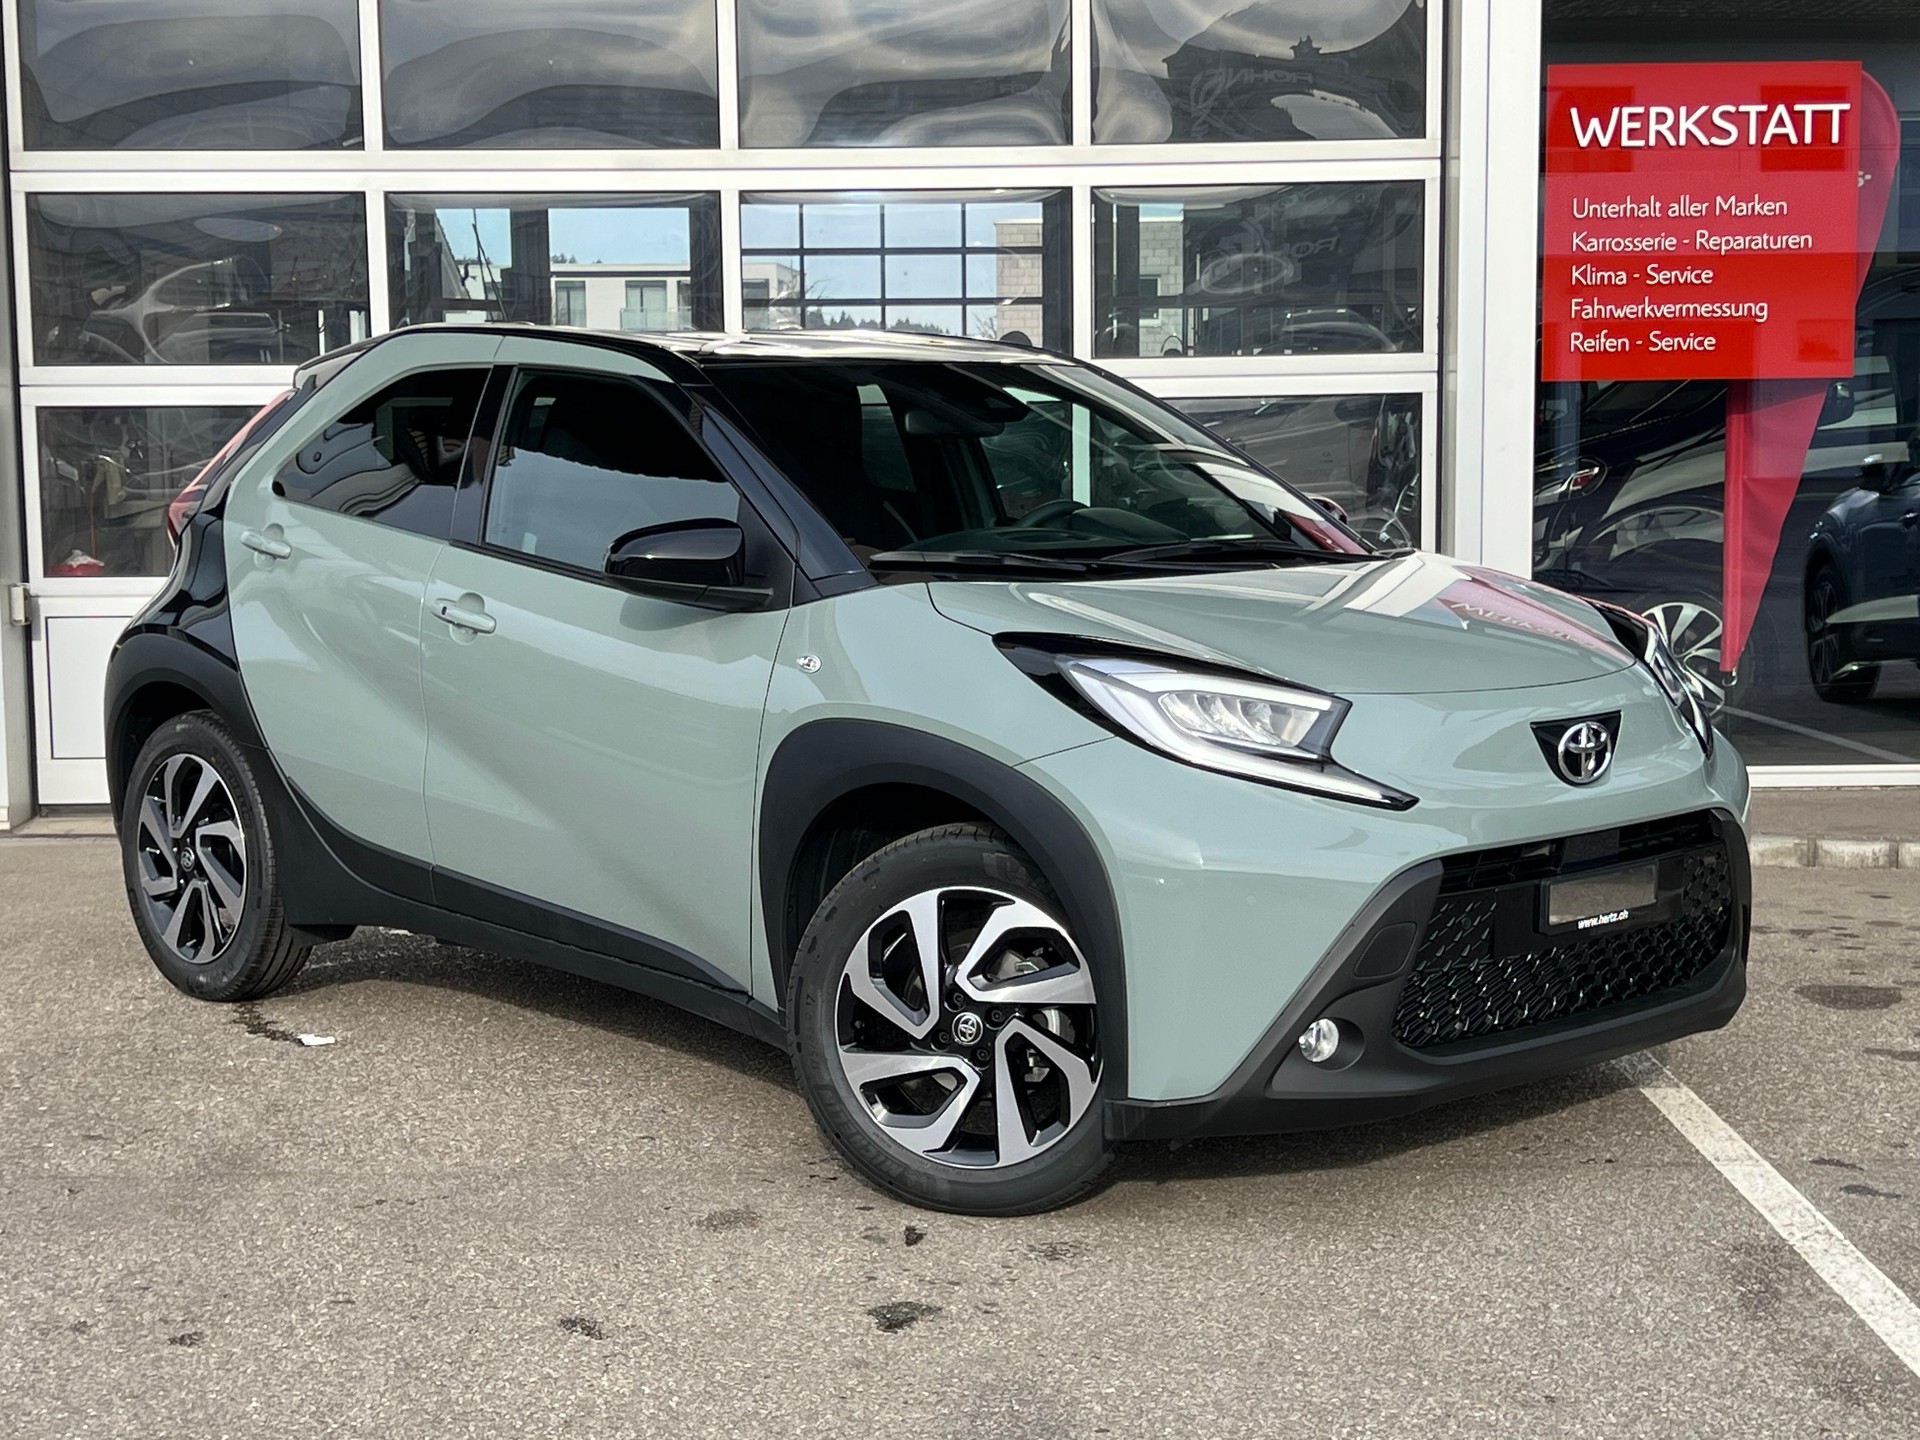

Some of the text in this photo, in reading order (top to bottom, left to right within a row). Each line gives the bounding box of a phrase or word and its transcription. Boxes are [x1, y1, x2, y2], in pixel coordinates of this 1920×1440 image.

[1569, 103, 1851, 148] WERKSTATT
[1572, 193, 1788, 219] Unterhalt aller Marken
[1572, 231, 1677, 252] Karrosserie
[1695, 229, 1813, 256] Reparaturen
[1571, 264, 1627, 285] Klima
[1645, 263, 1714, 285] Service
[1570, 296, 1768, 323] Fahrwerkvermessung
[1570, 329, 1629, 352] Reifen
[1648, 330, 1716, 351] Service
[1577, 908, 1629, 930] www.hertz.ch
